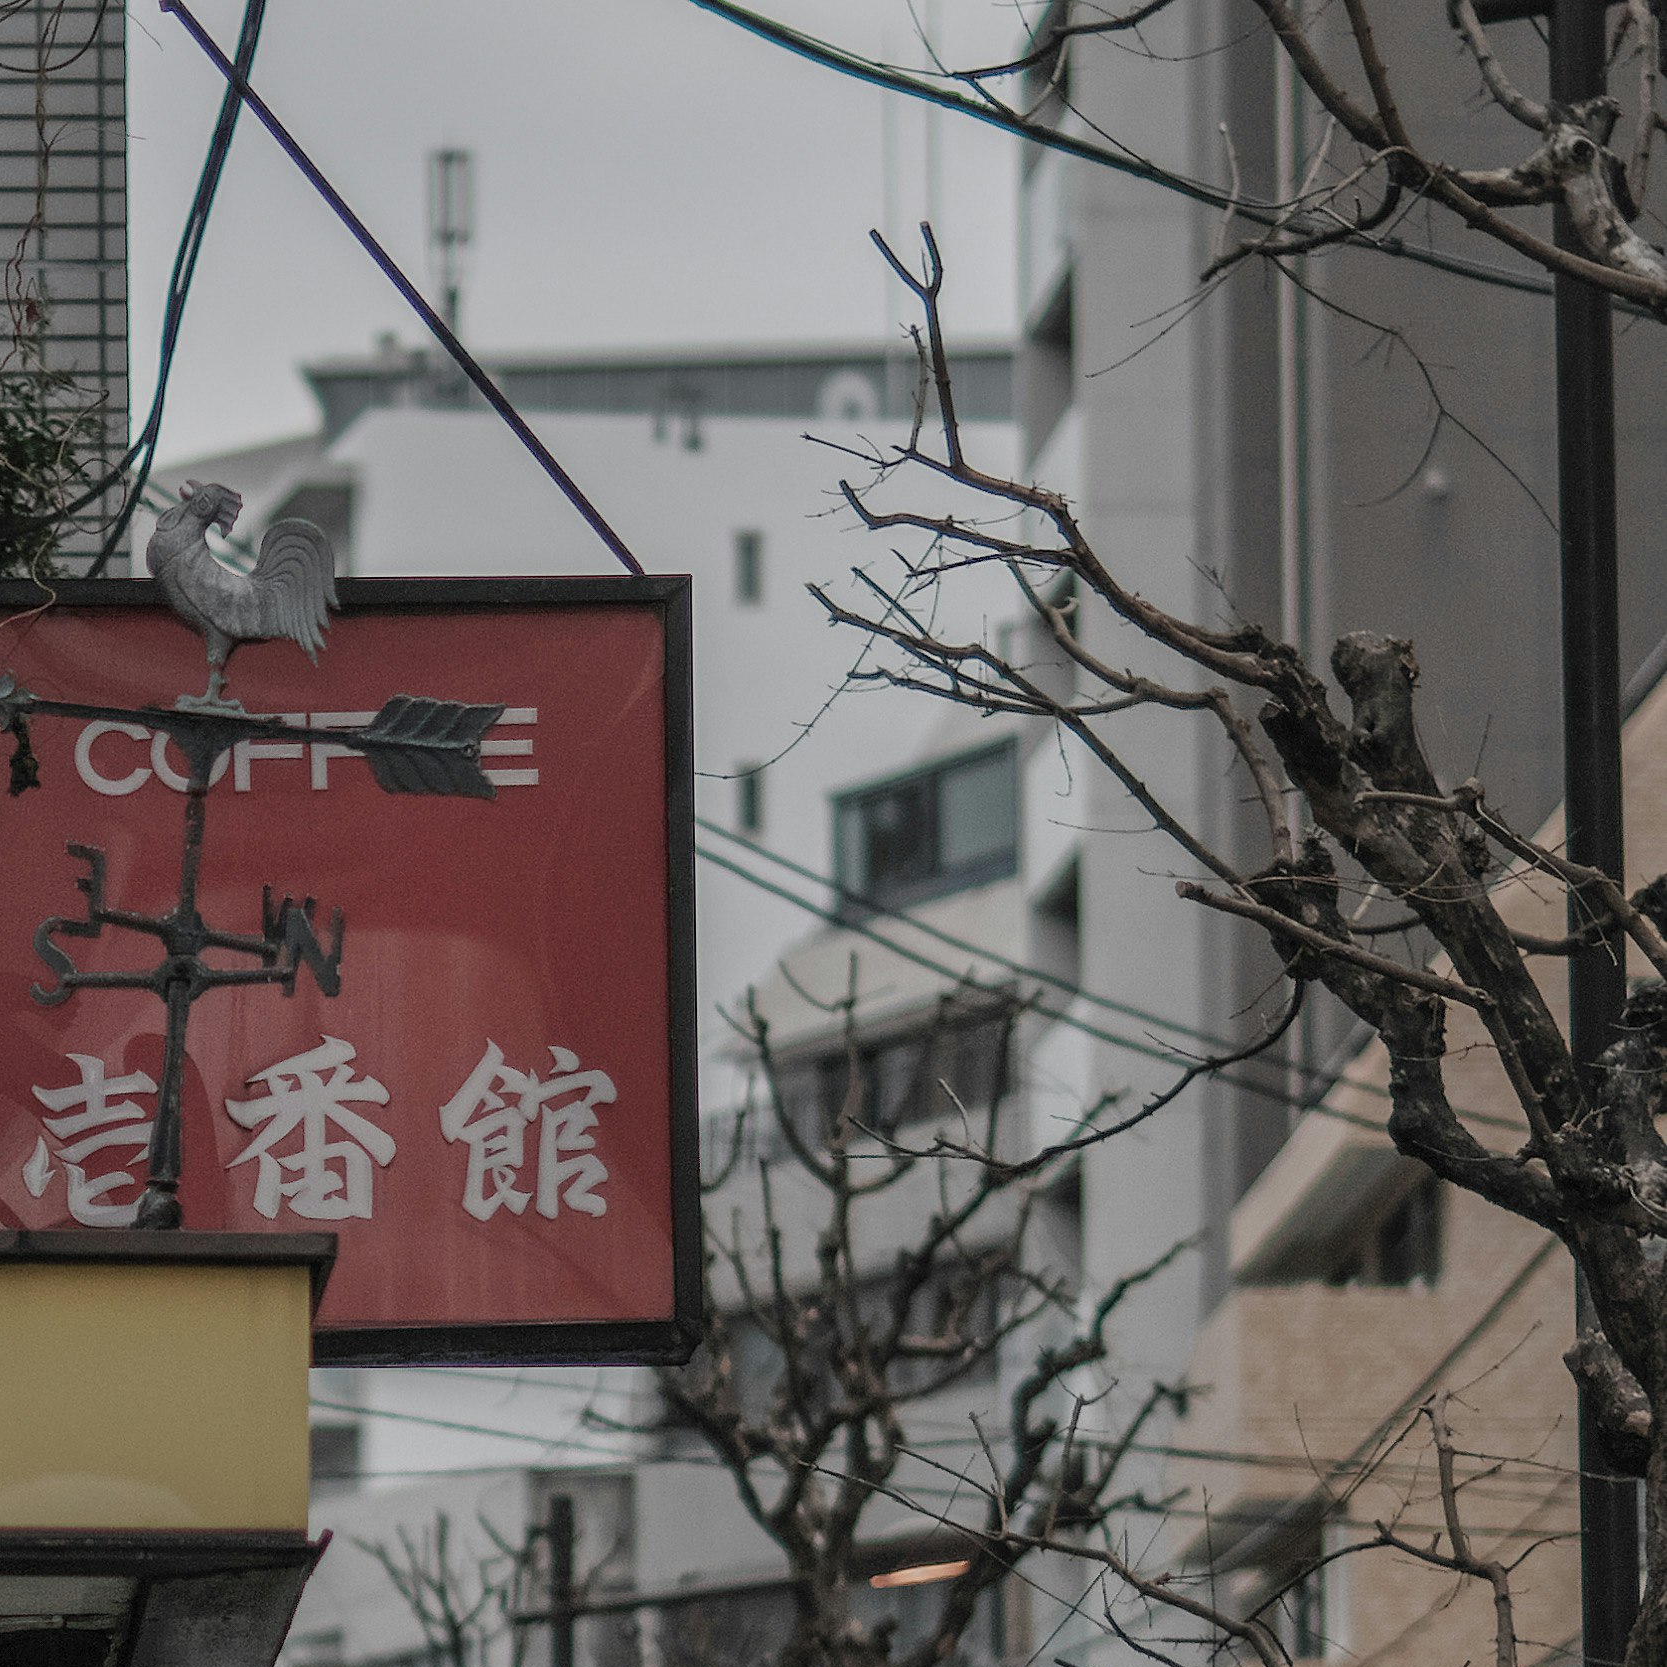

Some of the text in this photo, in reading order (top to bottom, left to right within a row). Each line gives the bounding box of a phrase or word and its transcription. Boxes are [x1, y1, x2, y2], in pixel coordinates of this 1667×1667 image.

[74, 707, 539, 796] COFFE
[282, 906, 344, 997] N
[22, 1035, 617, 1228] 壱番館
